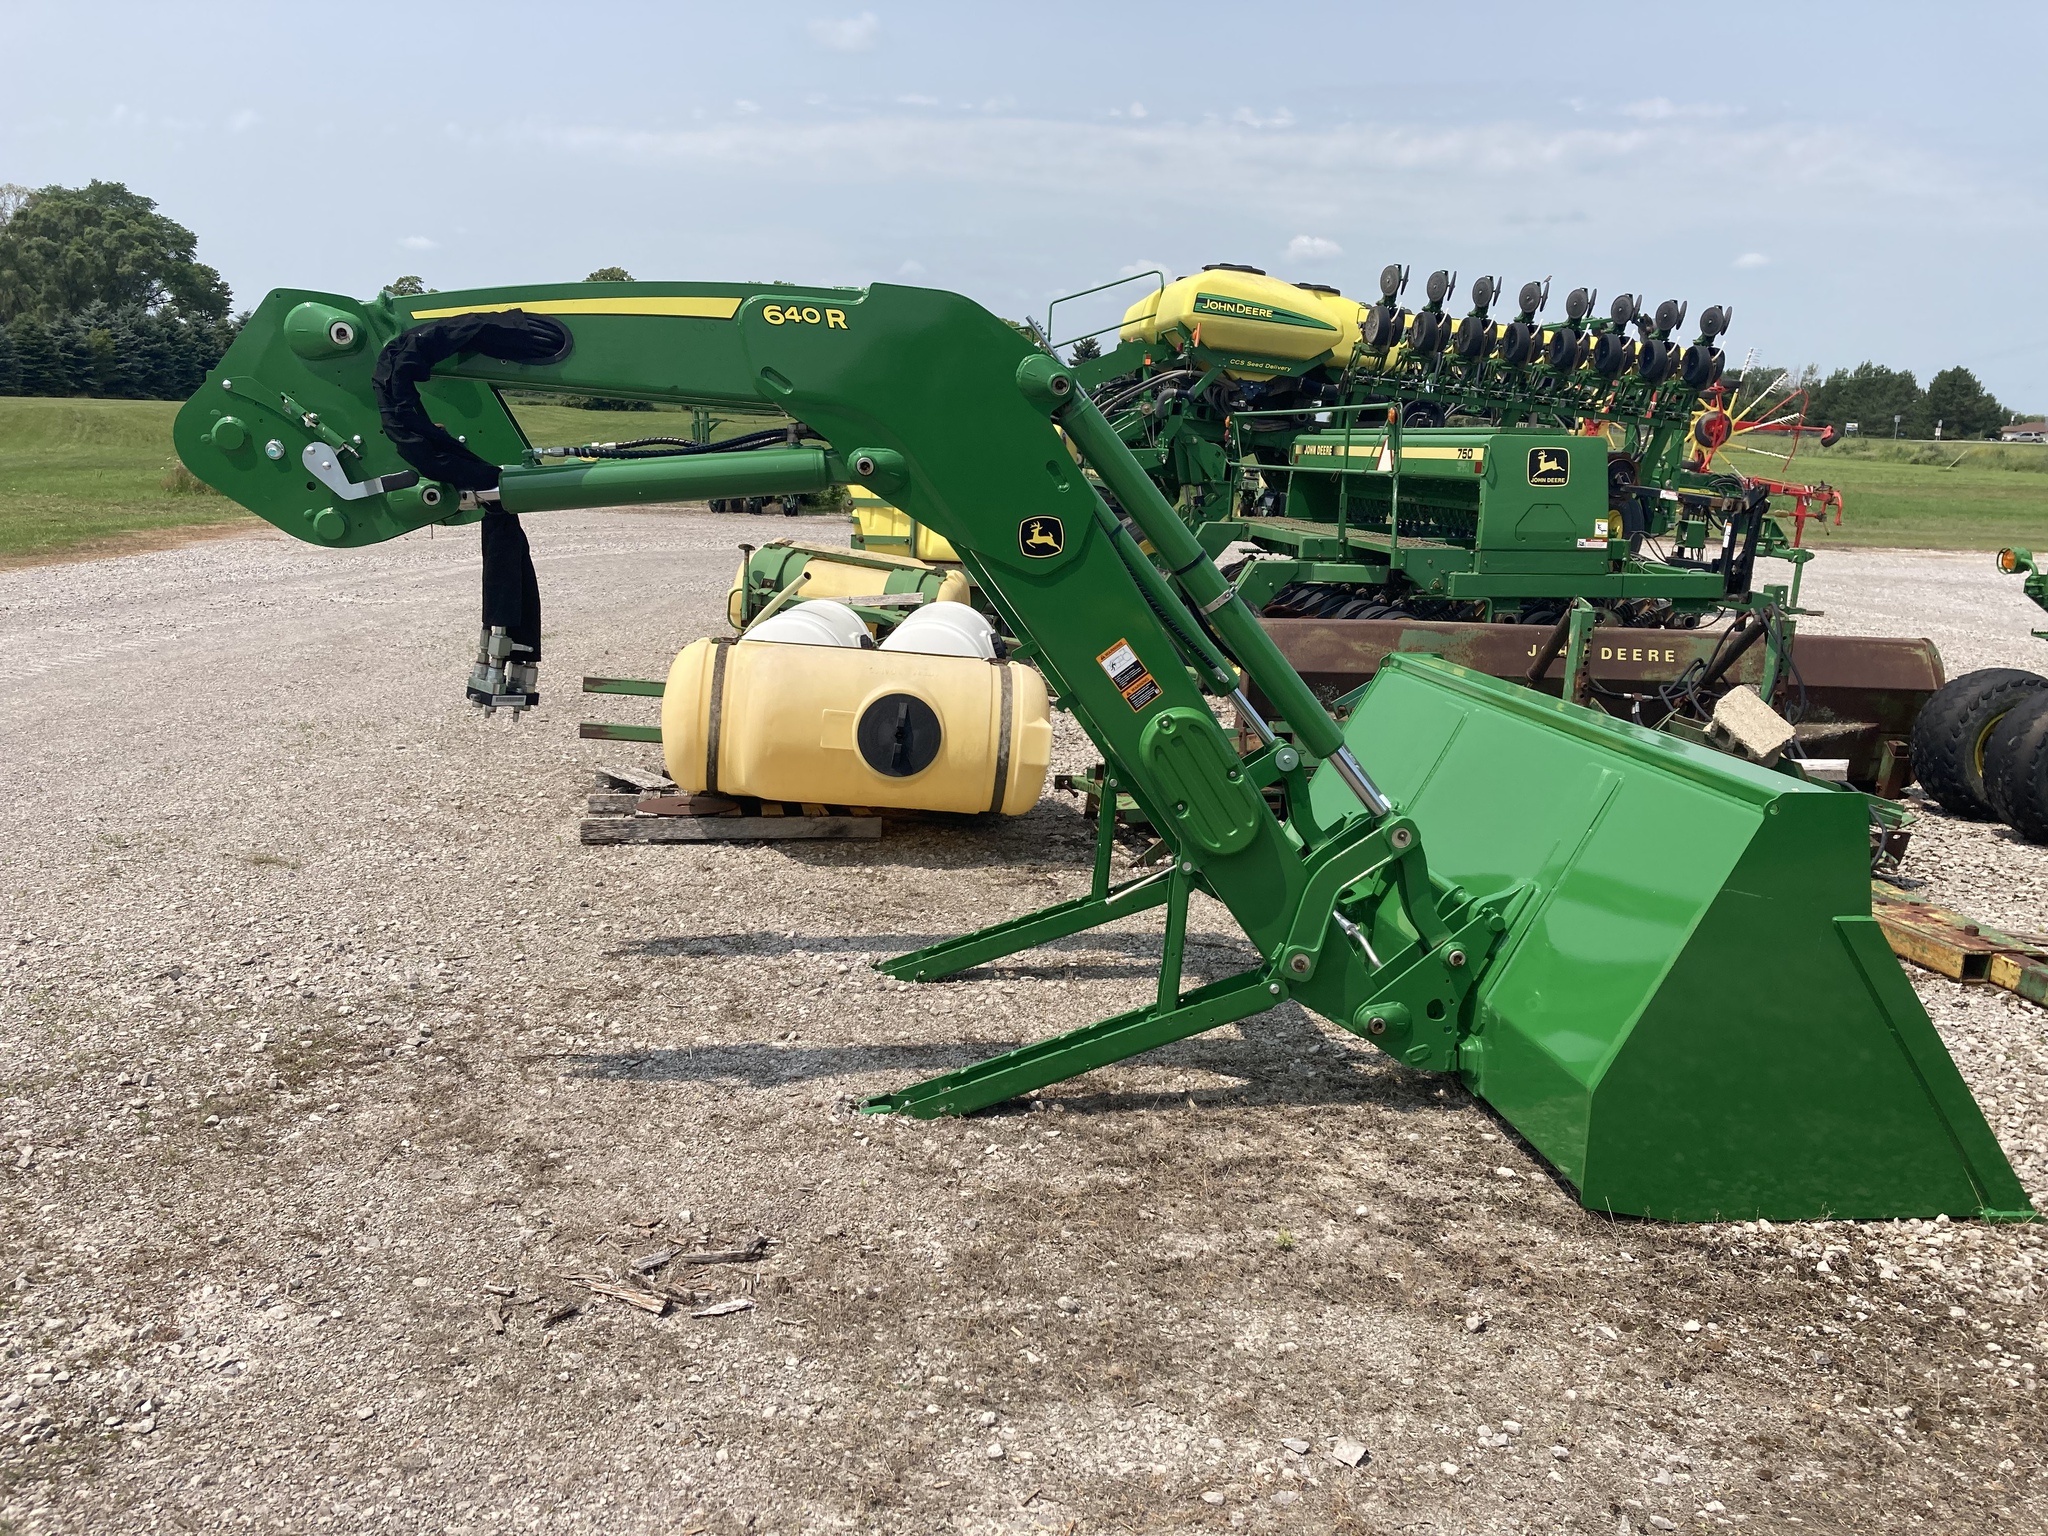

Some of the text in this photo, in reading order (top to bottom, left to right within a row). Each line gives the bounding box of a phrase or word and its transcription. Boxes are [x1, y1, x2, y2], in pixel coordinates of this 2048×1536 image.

[763, 305, 849, 329] 640 R
[1229, 358, 1245, 366] CCS
[1264, 363, 1292, 372] Delivery
[1304, 445, 1333, 456] JOHN DEERE
[1457, 448, 1474, 459] 750
[1601, 647, 1675, 662] DEERE
